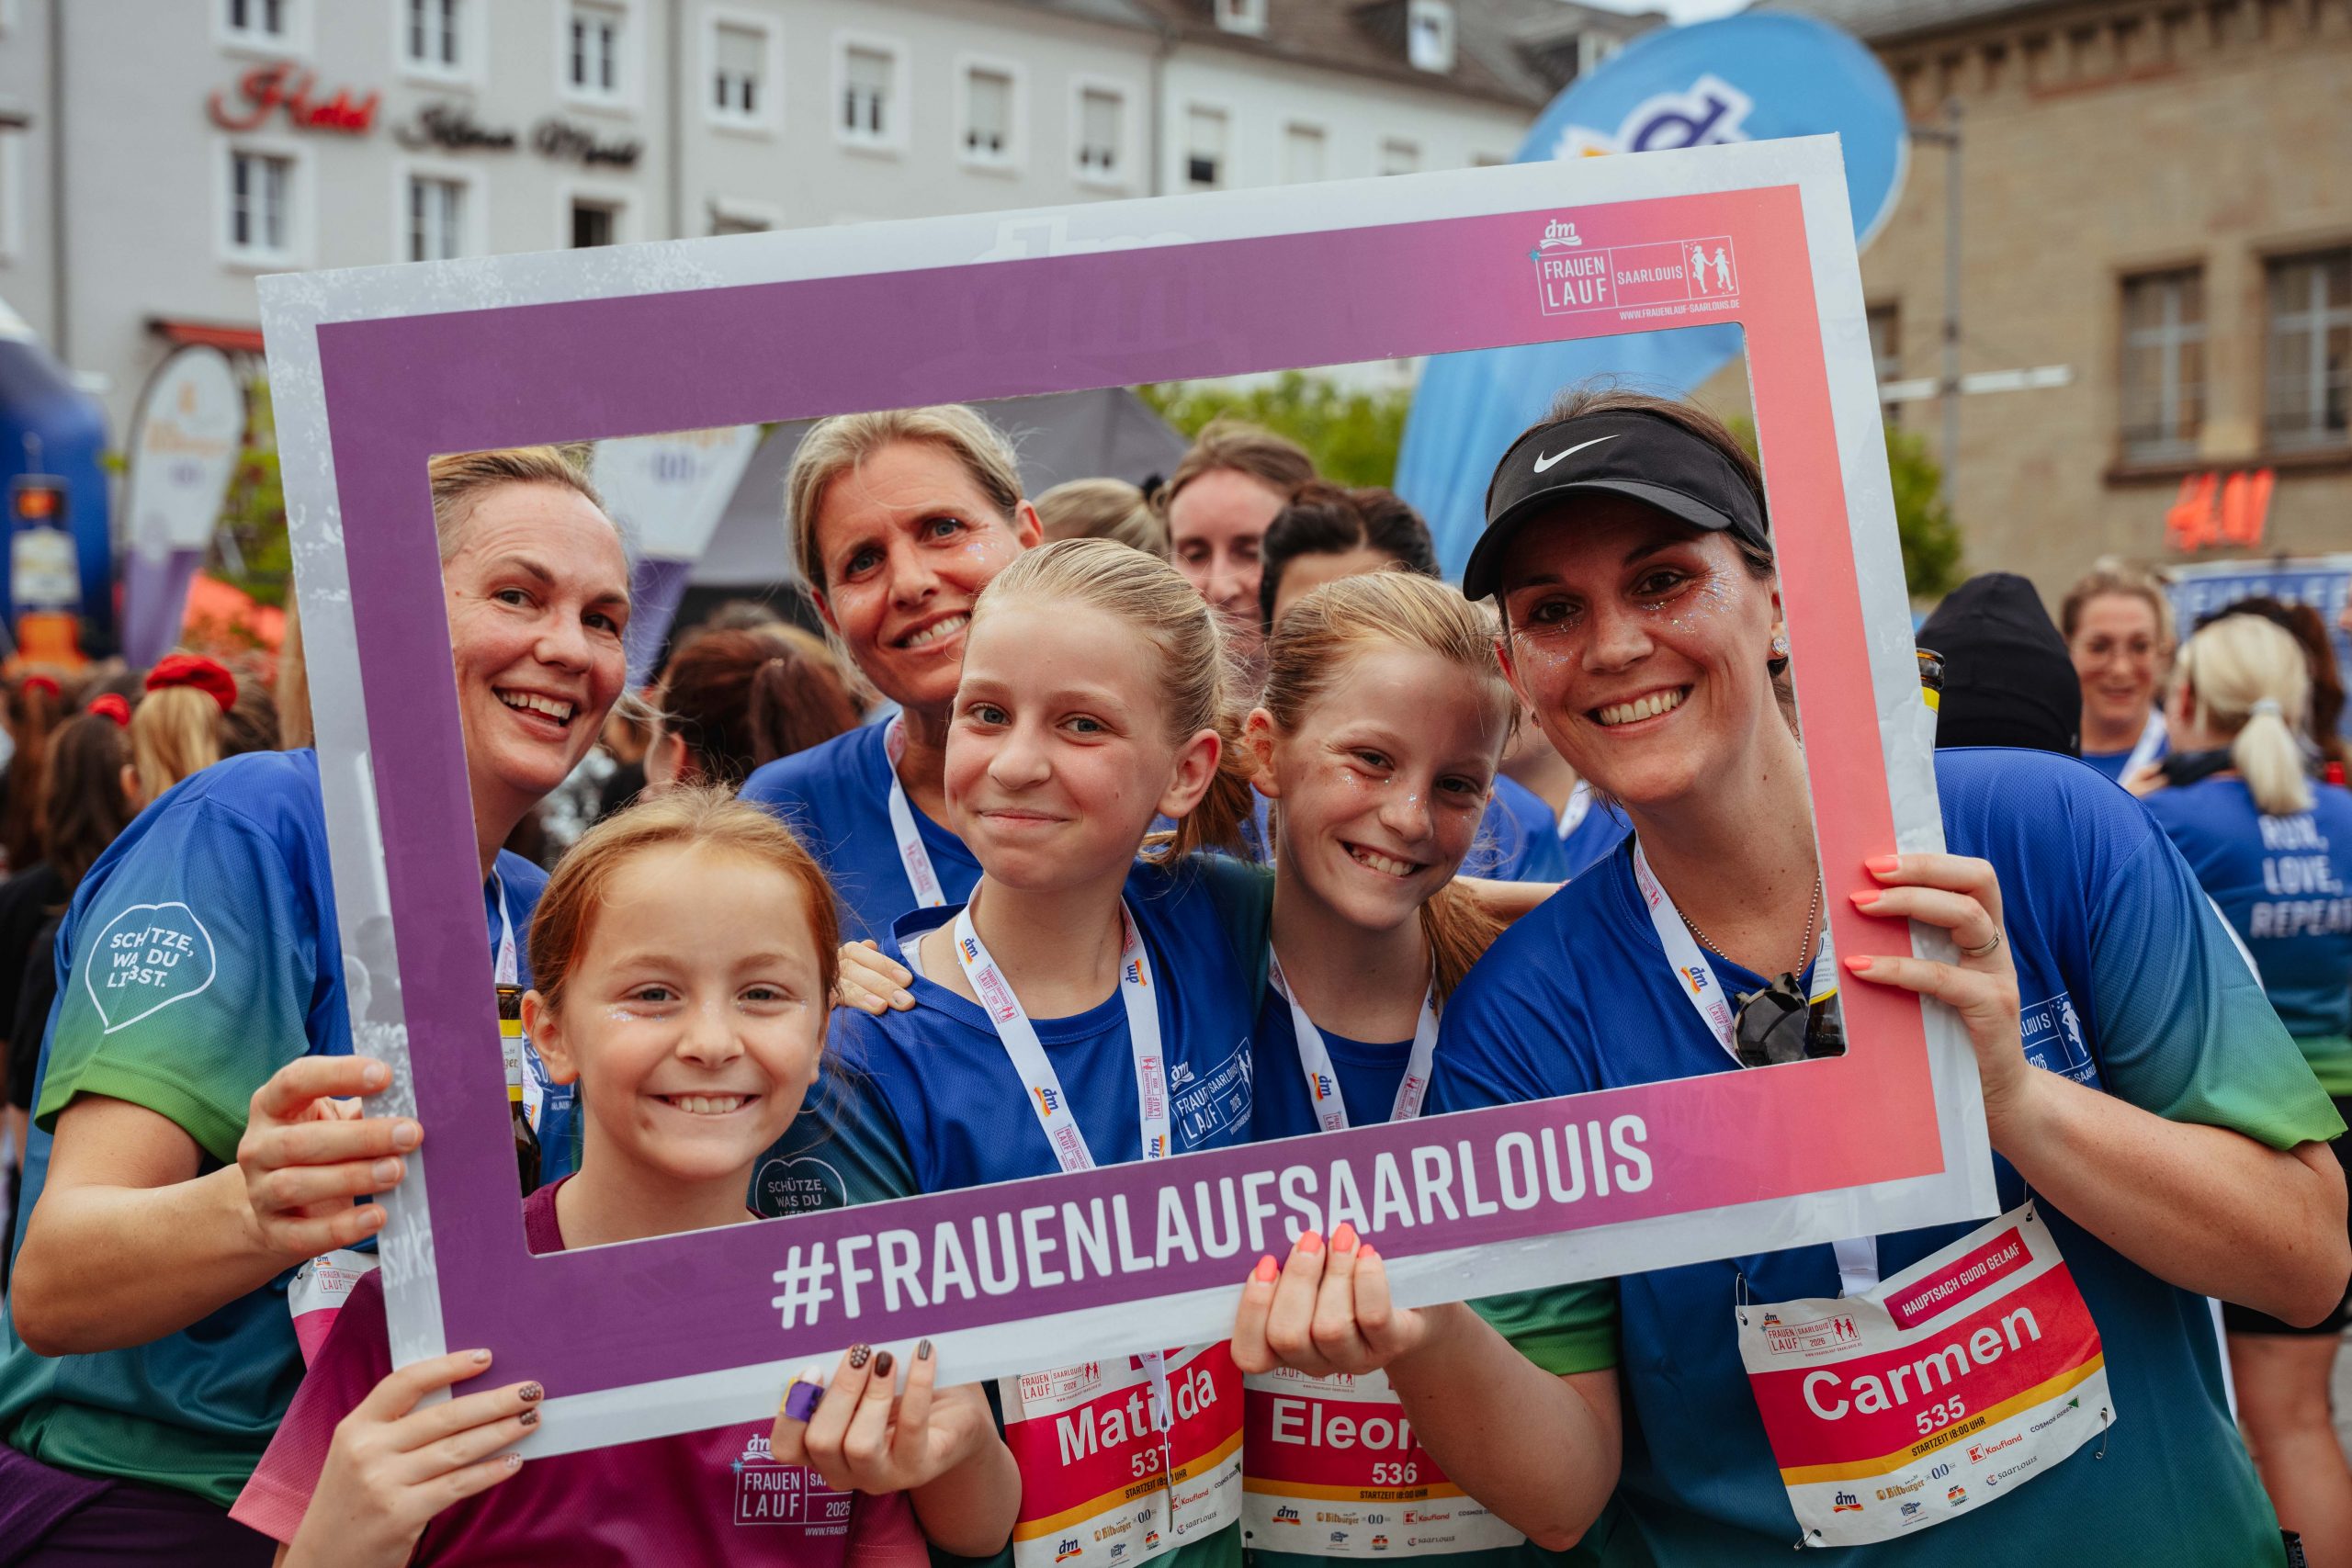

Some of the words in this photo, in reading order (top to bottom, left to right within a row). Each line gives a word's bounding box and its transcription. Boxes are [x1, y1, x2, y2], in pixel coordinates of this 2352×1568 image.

[1544, 219, 1576, 239] dm
[1544, 255, 1605, 280] FRAUEN
[1617, 265, 1683, 285] SAARLOUIS
[1546, 277, 1608, 308] LAUF
[1619, 299, 1740, 320] WWW.FRAUENLAUF-SAARLOUIS.DE
[965, 938, 978, 957] dm
[146, 948, 180, 967] DU
[1125, 964, 1139, 983] dm
[1690, 967, 1708, 987] dm
[1709, 1006, 1724, 1024] LAUF
[1170, 1061, 1189, 1082] dm
[1318, 1075, 1331, 1097] dm
[1042, 1088, 1059, 1111] dm
[1057, 1130, 1072, 1151] LAUF
[1148, 1138, 1160, 1159] dm
[767, 1178, 827, 1193] SCHÜTZE,
[775, 1195, 799, 1208] WAS
[802, 1194, 822, 1206] DU
[772, 1114, 1654, 1330] #FRAUENLAUFSAARLOUIS
[322, 1280, 343, 1290] LAUF
[1902, 1277, 1961, 1317] HAUPTSACH
[1959, 1262, 1987, 1286] GUDD
[1985, 1242, 2020, 1270] GELAAF
[1764, 1313, 1778, 1321] dm
[1768, 1328, 1795, 1339] FRAUEN
[1797, 1323, 1829, 1335] SAARLOUIS
[1770, 1338, 1798, 1351] LAUF
[1053, 1366, 1083, 1380] SAARLOUIS
[1803, 1307, 2042, 1421] Carmen
[1022, 1373, 1049, 1388] FRAUEN
[1023, 1383, 1051, 1400] LAUF
[1916, 1394, 1966, 1435] 535
[2030, 1416, 2056, 1433] COSMOS
[1911, 1433, 1950, 1457] STARTZEIT
[1949, 1425, 1970, 1442] 18:00
[1968, 1416, 1986, 1431] UHR
[1985, 1433, 2023, 1456] Kaufland
[744, 1472, 800, 1491] FRAUEN
[1371, 1461, 1419, 1485] 536
[1125, 1479, 1156, 1499] STARTZEIT
[1174, 1468, 1187, 1481] UHR
[1885, 1478, 1925, 1500] Bitburger
[1181, 1487, 1209, 1506] Kaufland
[1360, 1489, 1395, 1500] STARTZEIT
[1414, 1488, 1429, 1499] UHR
[1835, 1491, 1857, 1505] dm
[741, 1493, 800, 1517] LAUF
[826, 1500, 851, 1517] 2025
[1276, 1506, 1299, 1519] dm
[1325, 1512, 1360, 1526] Bitburger
[1418, 1512, 1451, 1522] Kaufland
[1101, 1521, 1132, 1540] Bitburger
[1058, 1539, 1079, 1555] dm
